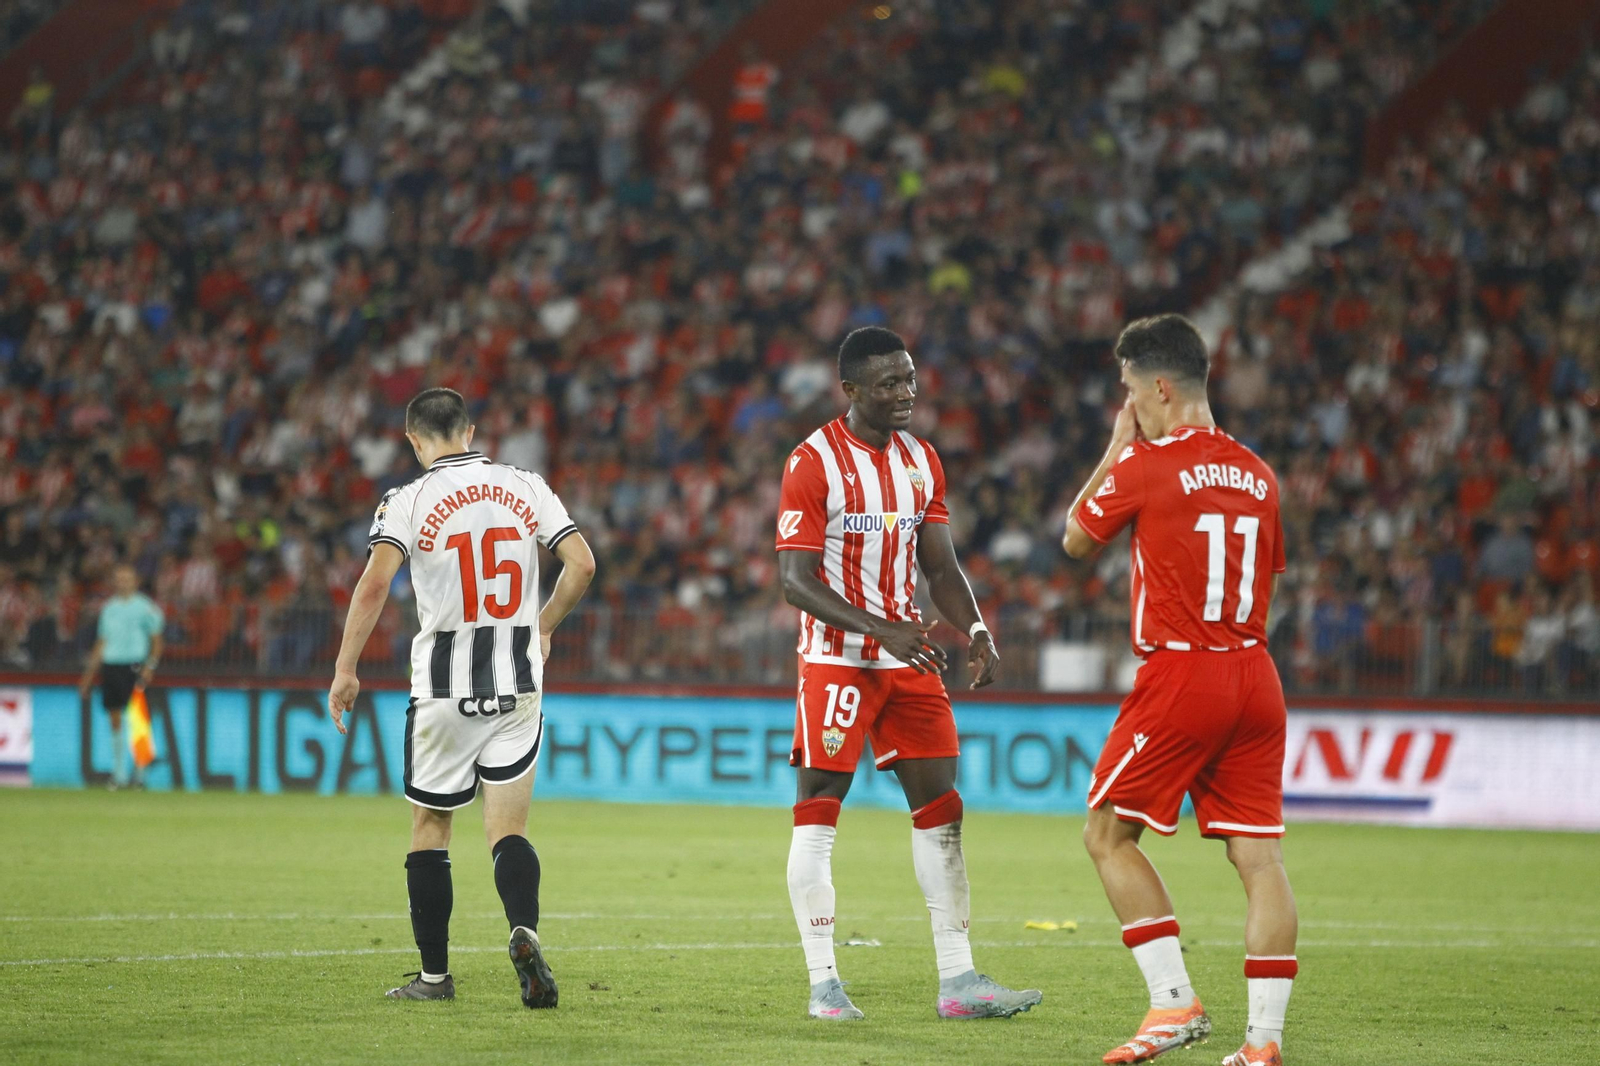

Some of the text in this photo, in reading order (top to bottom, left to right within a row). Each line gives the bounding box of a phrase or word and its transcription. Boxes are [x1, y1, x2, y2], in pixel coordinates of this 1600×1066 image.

[1179, 463, 1268, 501] ARRIBAS
[418, 484, 539, 553] GERENABARRENA
[843, 514, 882, 532] KUDU
[445, 527, 522, 623] 15
[1194, 513, 1260, 624] 11
[824, 683, 861, 728] 19
